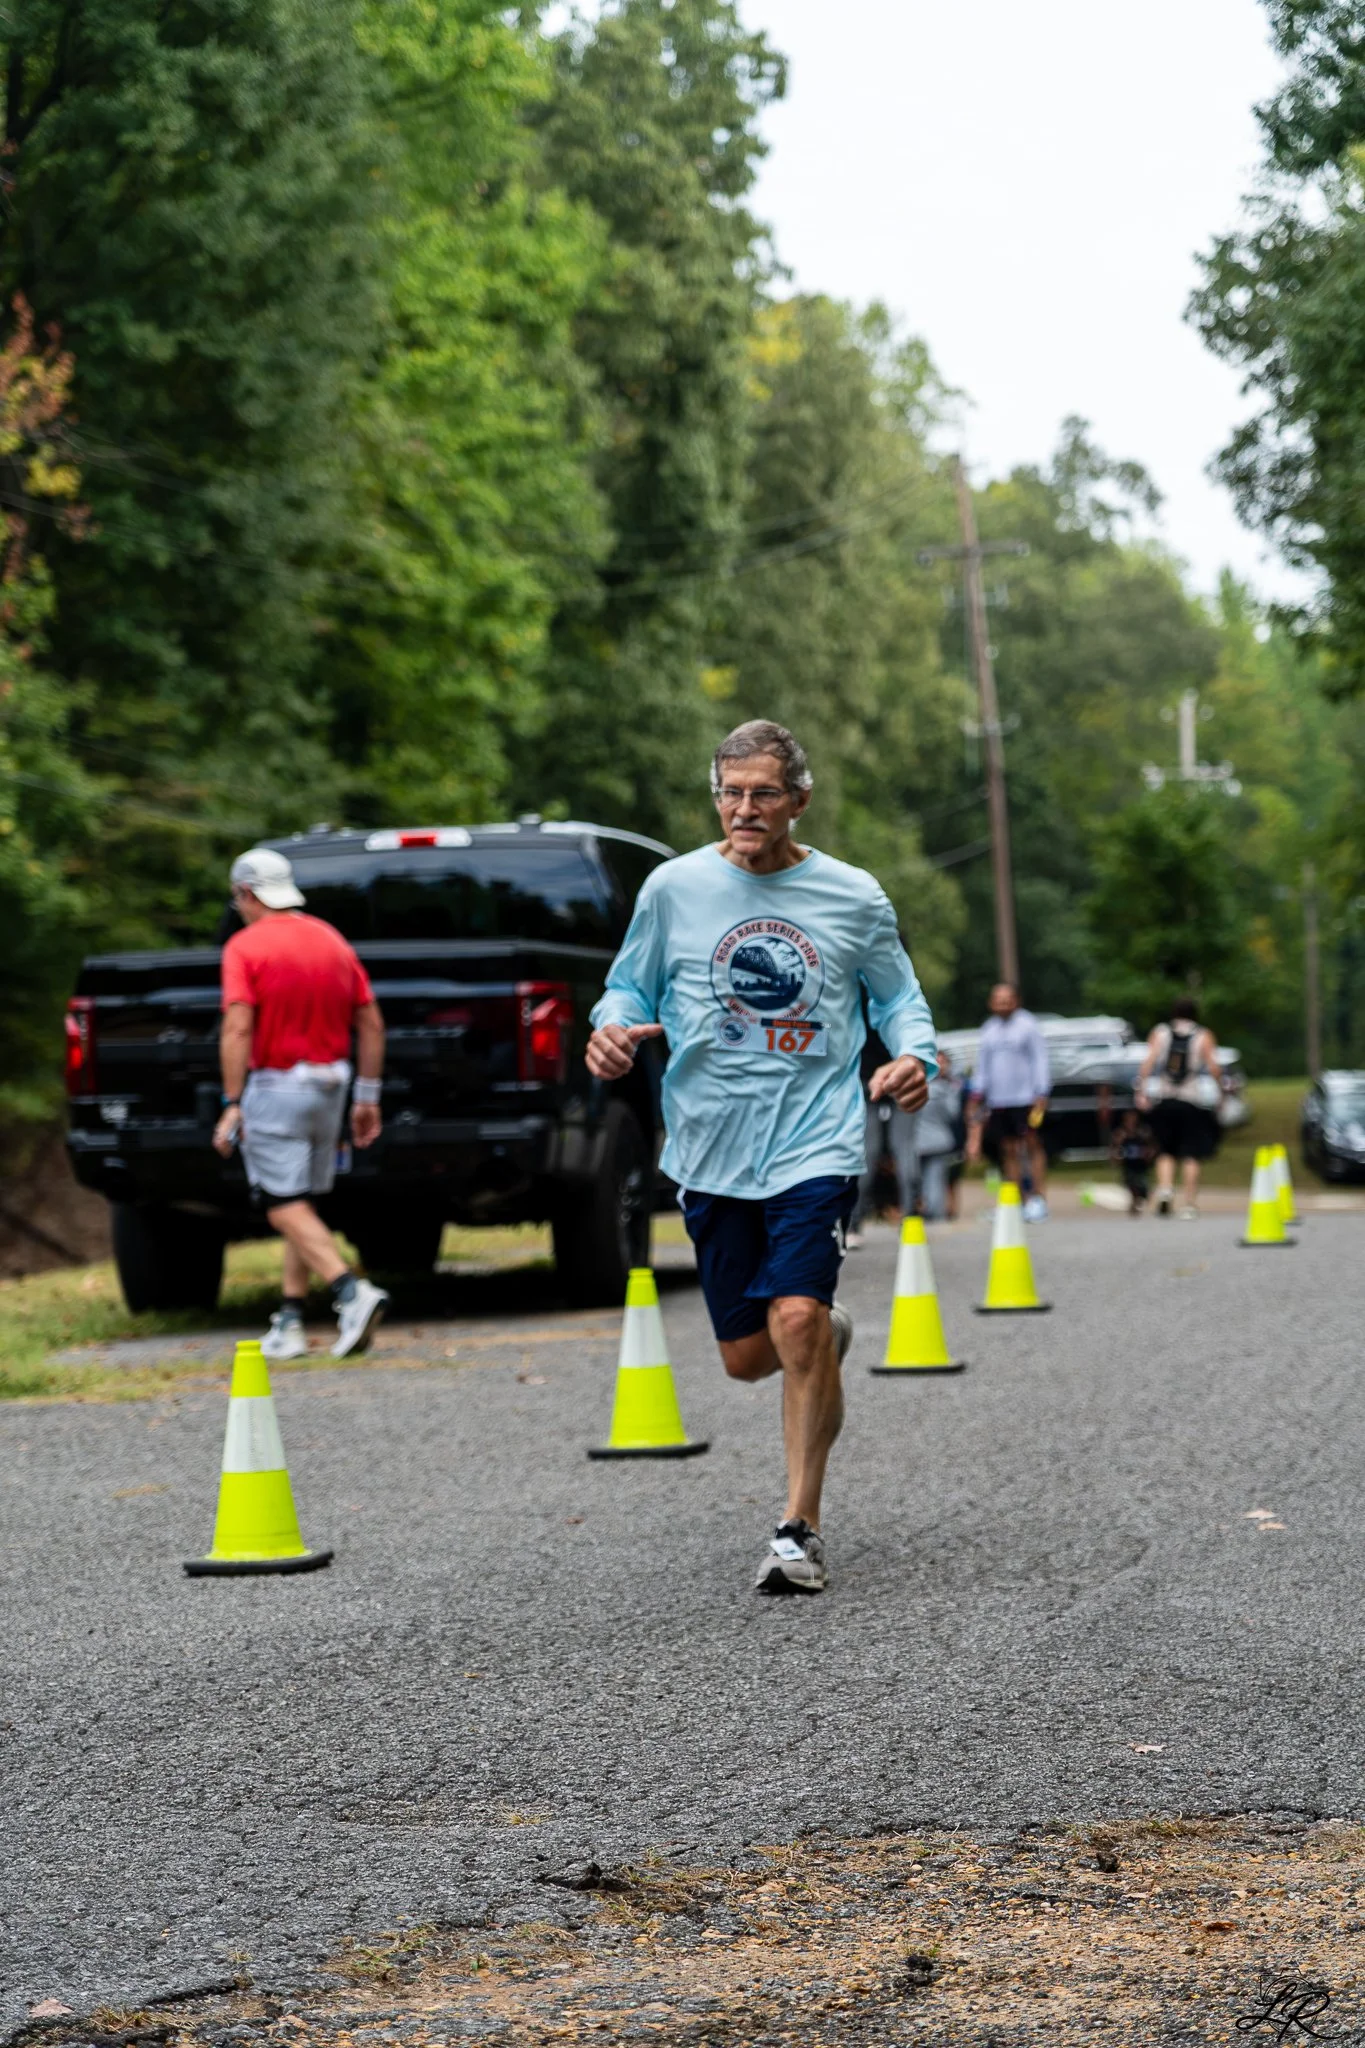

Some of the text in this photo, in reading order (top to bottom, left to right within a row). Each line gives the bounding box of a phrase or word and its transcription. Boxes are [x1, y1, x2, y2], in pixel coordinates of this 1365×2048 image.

[714, 935, 737, 963] ROAD
[736, 921, 765, 940] RACE
[765, 921, 803, 944] SERIES
[766, 1029, 816, 1054] 167
